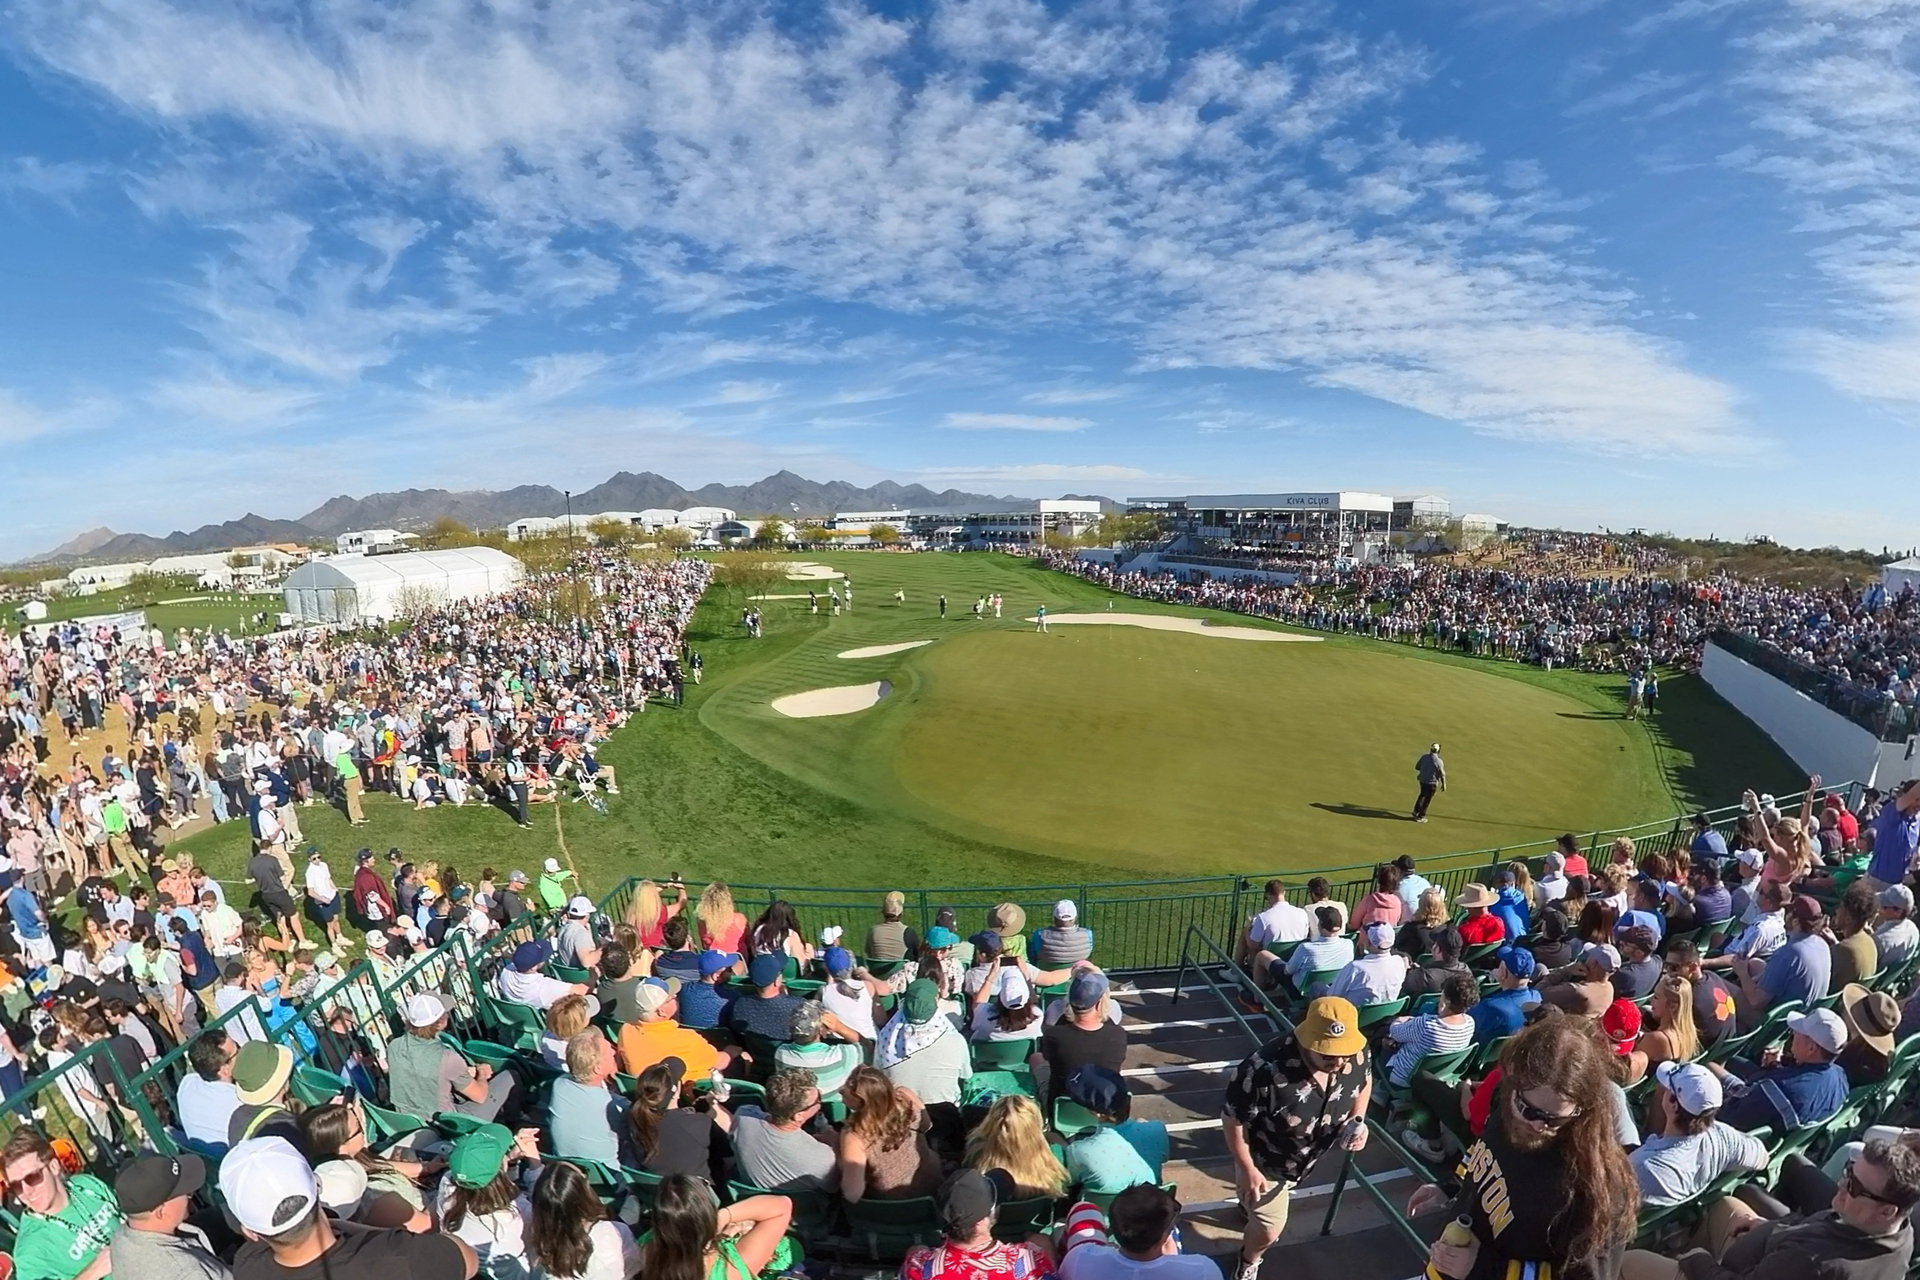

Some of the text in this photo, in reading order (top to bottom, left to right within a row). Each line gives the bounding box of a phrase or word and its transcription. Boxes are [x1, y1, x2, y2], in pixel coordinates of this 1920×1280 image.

[1286, 496, 1329, 505] KIVA CLUB
[1467, 1138, 1515, 1240] OSTON
